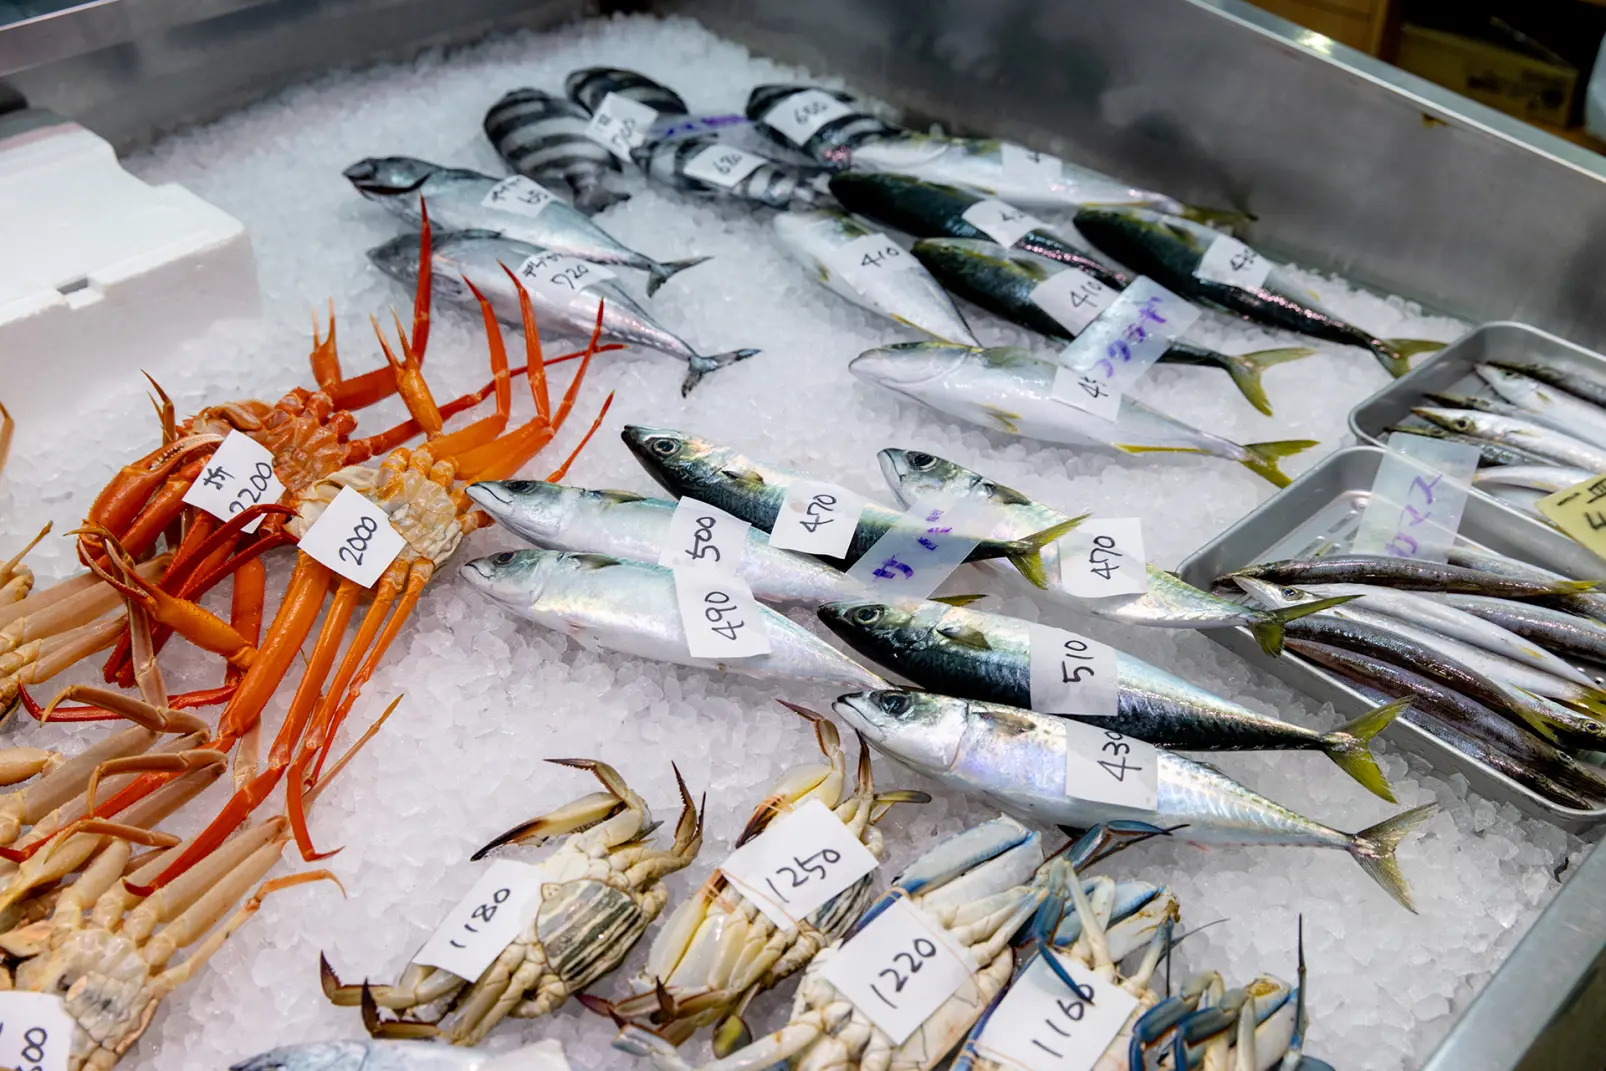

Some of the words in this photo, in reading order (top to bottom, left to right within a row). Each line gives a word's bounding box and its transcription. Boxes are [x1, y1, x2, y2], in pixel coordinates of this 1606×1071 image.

[861, 246, 900, 267] 410
[1069, 280, 1103, 308] 410
[799, 493, 838, 534] 470
[338, 516, 378, 567] 2000
[684, 516, 721, 563] 500
[1088, 534, 1118, 581] 470
[703, 590, 745, 641] 490
[1060, 639, 1096, 684] 510
[1096, 730, 1143, 782] 430
[765, 847, 842, 904] 1250
[449, 887, 513, 950] 1180
[870, 937, 938, 1006] 1220
